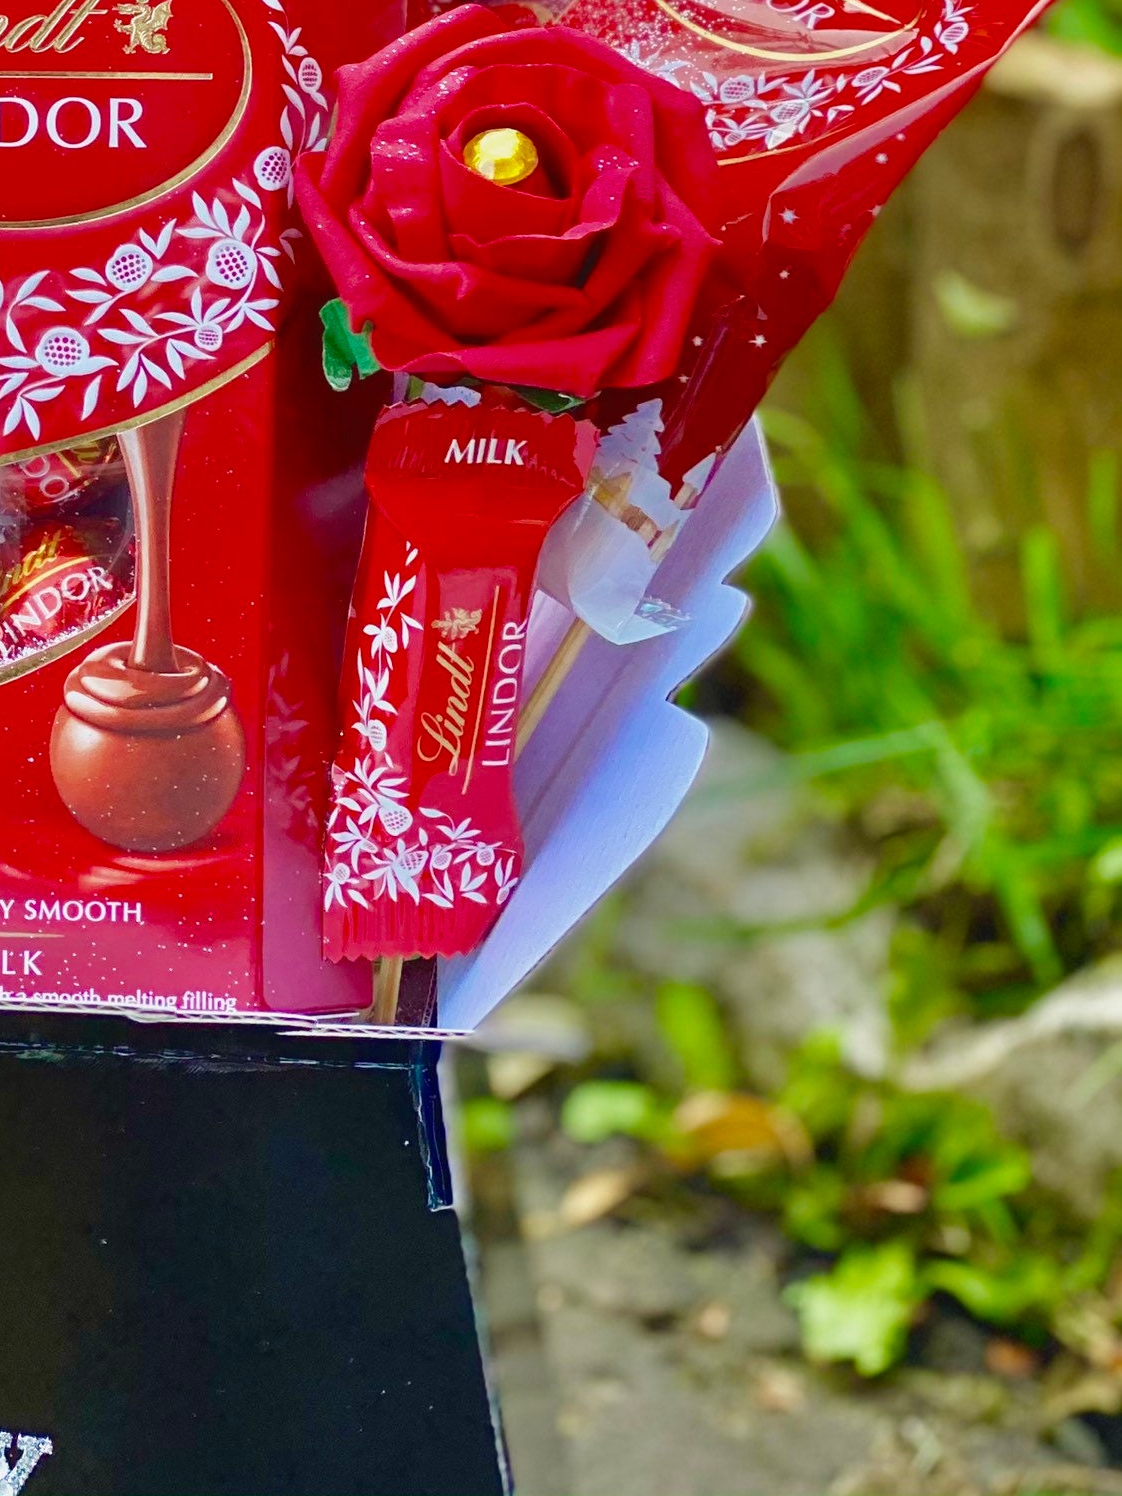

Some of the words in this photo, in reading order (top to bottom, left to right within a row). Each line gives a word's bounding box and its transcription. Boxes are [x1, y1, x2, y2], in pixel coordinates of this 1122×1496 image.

[445, 439, 528, 466] MILK
[481, 617, 530, 769] LINDOR
[417, 641, 481, 777] Lindt
[23, 896, 143, 923] SMOOTH
[107, 989, 178, 1008] melting
[182, 990, 238, 1013] filling
